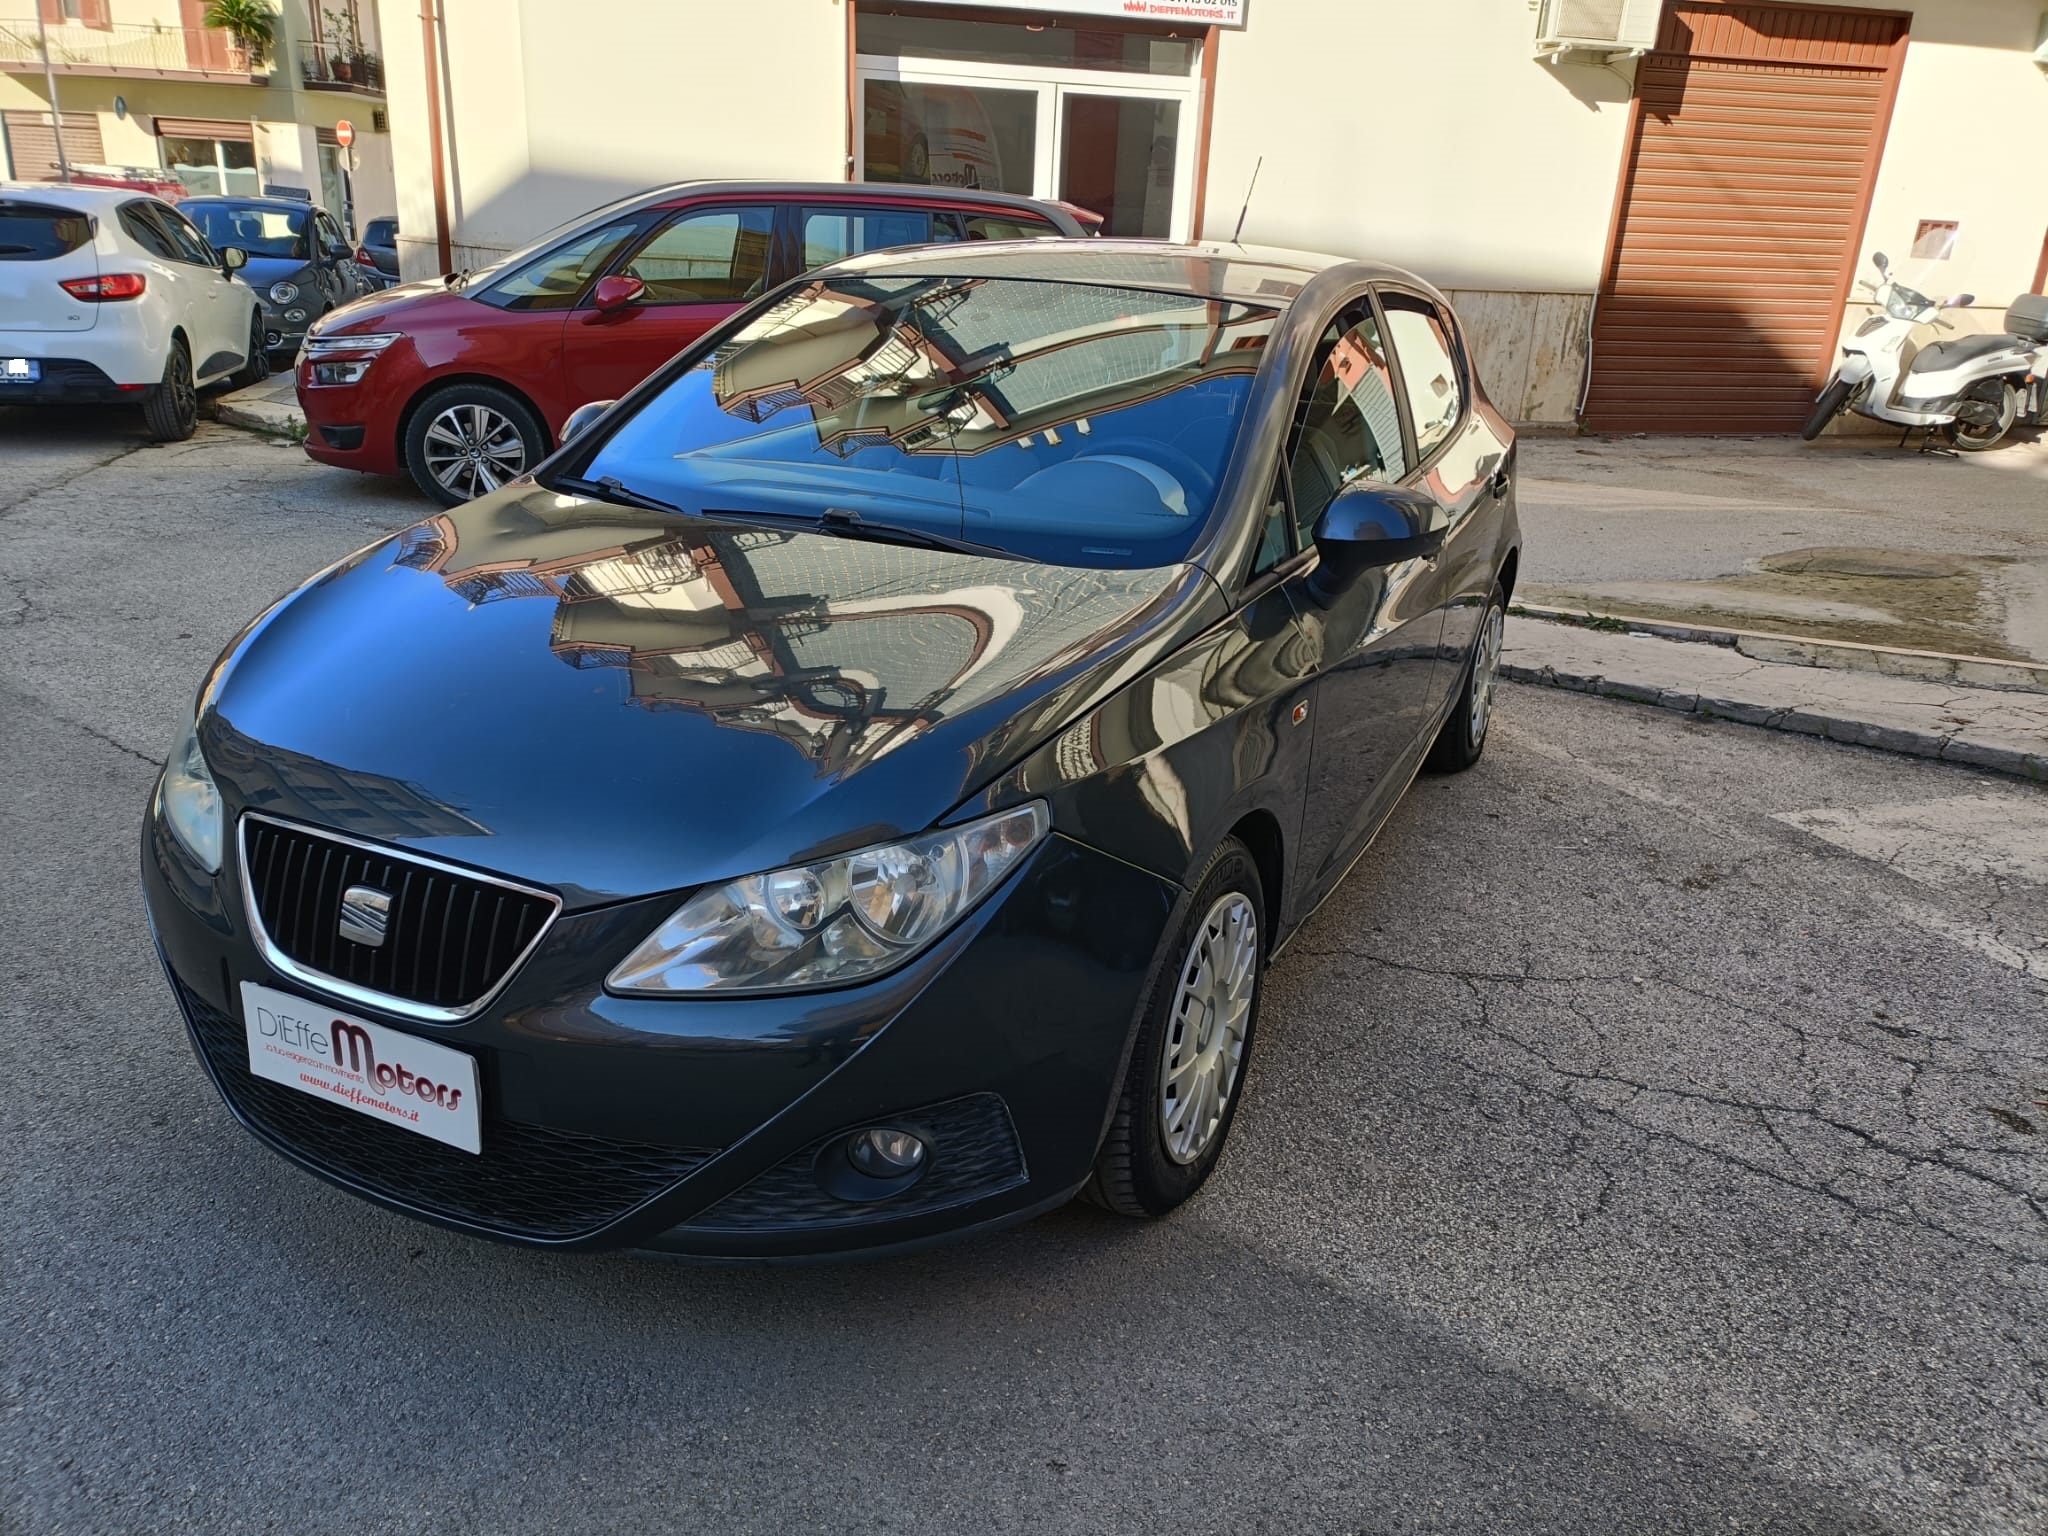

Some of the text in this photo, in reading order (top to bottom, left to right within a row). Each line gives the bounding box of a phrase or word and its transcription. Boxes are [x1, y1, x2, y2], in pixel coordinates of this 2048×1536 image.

[257, 1007, 462, 1111] DiEffe Motors
[299, 1072, 420, 1122] www.dieffemotors.it
